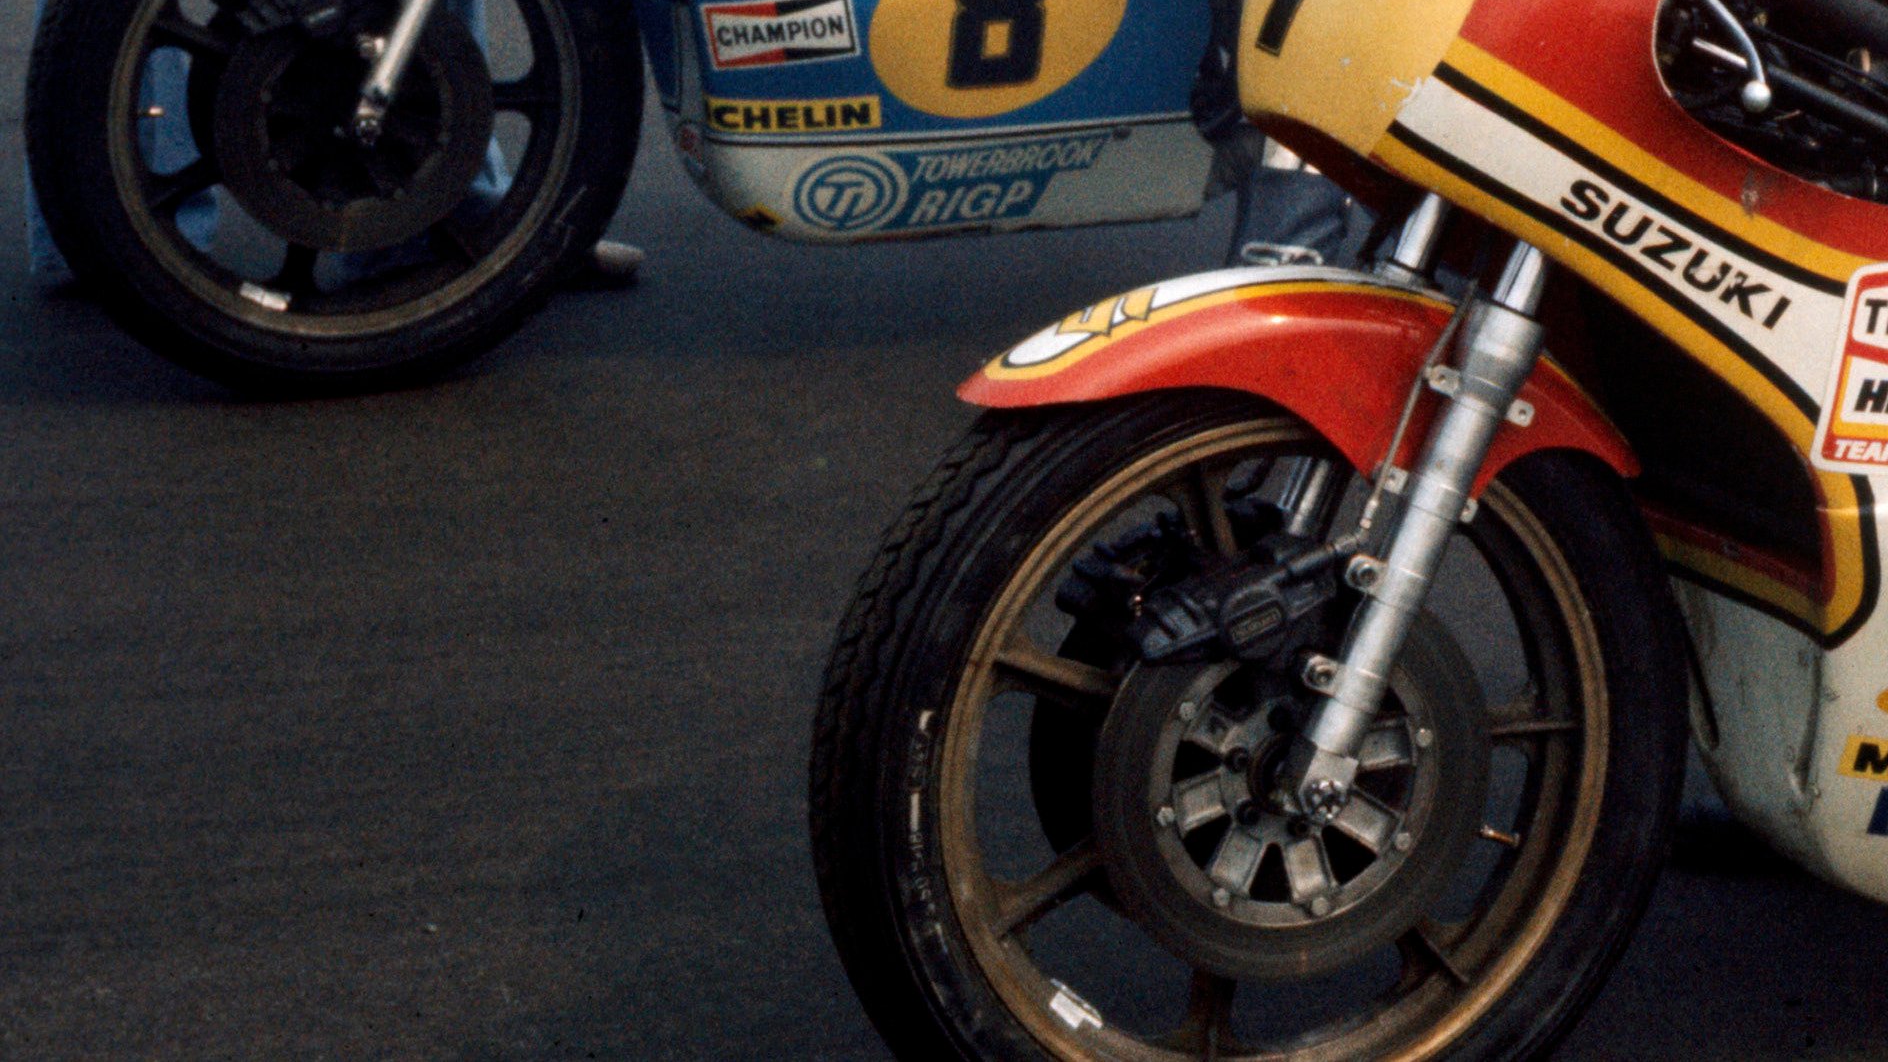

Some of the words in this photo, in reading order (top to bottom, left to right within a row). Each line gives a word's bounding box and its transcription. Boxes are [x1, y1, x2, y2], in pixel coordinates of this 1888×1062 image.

[714, 14, 846, 48] CHAMPION
[712, 103, 872, 129] CHELIN
[910, 137, 1101, 184] TOWERBROOK
[1560, 179, 1792, 331] SUZUKI
